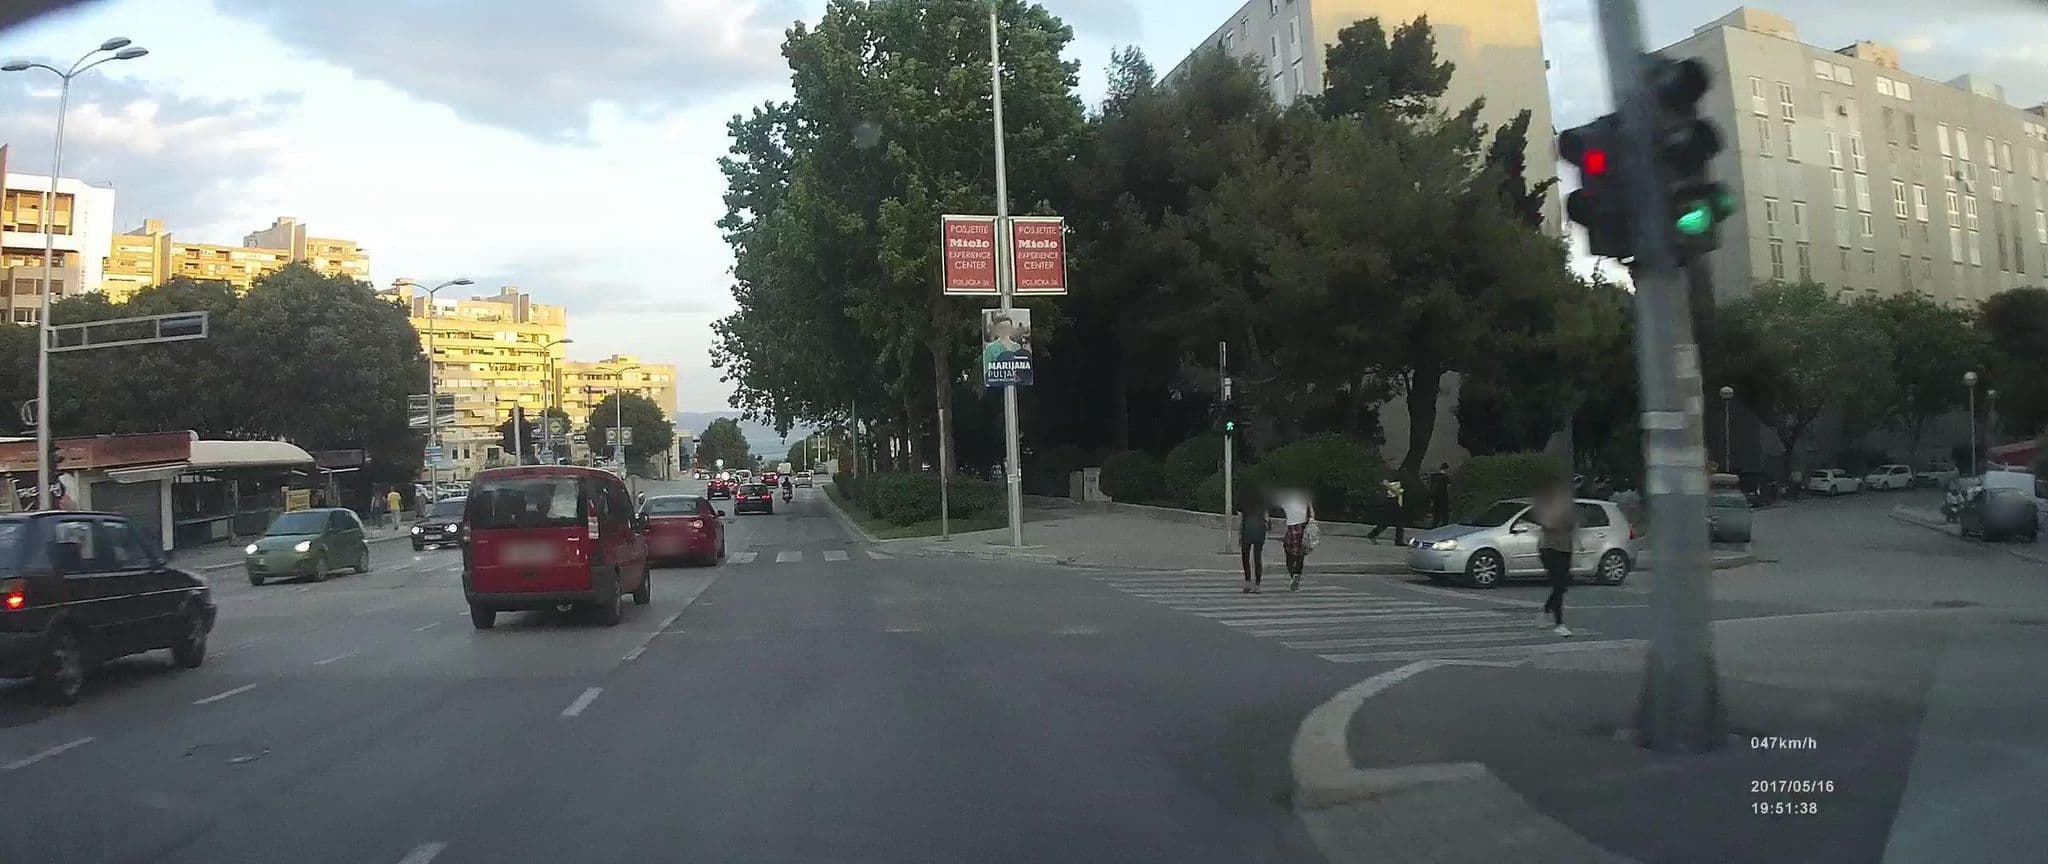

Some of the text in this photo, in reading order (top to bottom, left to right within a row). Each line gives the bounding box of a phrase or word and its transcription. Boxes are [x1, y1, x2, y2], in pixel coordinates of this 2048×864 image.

[950, 225, 988, 234] POSJETITE
[950, 238, 990, 248] Miele
[1018, 239, 1058, 248] Miele
[949, 251, 991, 259] EXPERIENCE
[1018, 251, 1058, 259] EXPERIENCE
[954, 261, 987, 270] CENTER
[1023, 261, 1054, 270] CENTER
[988, 361, 1031, 370] MARIJANA
[988, 370, 1017, 379] PULJAK
